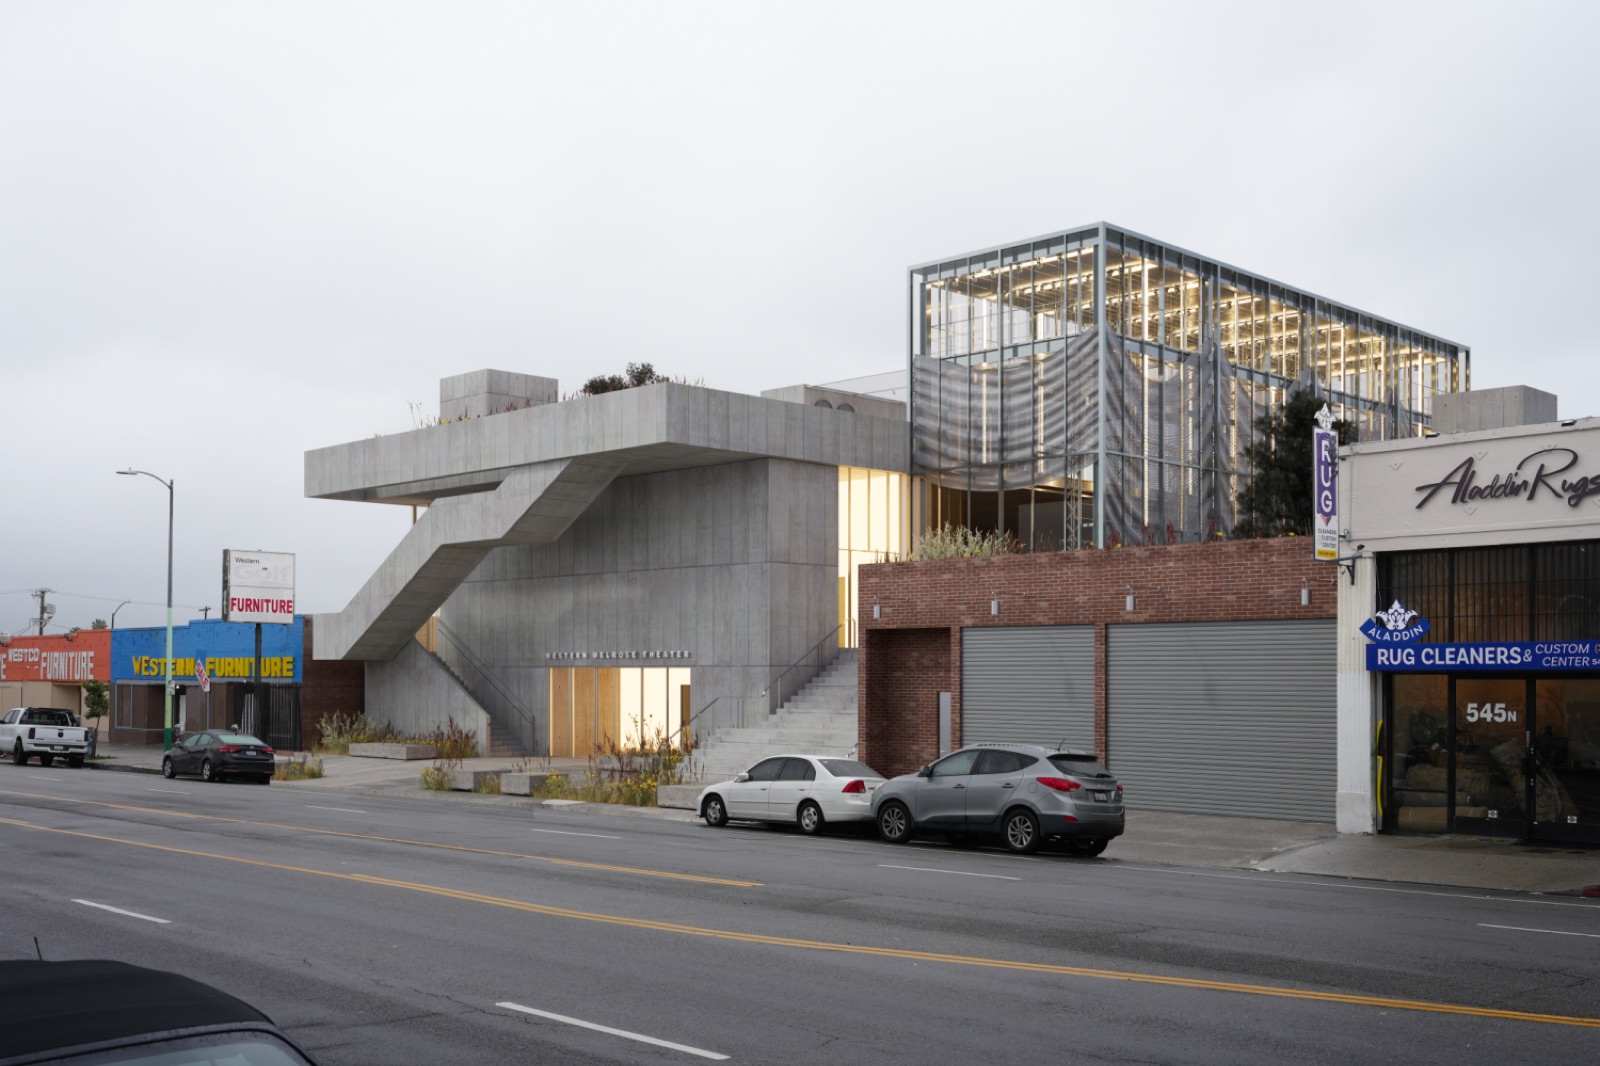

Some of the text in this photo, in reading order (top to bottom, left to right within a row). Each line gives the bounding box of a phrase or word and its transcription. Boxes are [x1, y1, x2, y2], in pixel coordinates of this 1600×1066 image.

[1320, 440, 1333, 513] RUG
[1415, 448, 1600, 509] Aladdin Rugs
[235, 556, 260, 565] Western
[230, 597, 293, 614] FURNITURE
[1367, 624, 1424, 642] ALADDIN
[8, 648, 40, 662] WESTCO
[545, 650, 690, 659] WESTERN MELROSE THEATER
[1377, 647, 1533, 665] RUG CLEANERS &
[1535, 643, 1590, 655] CUSTOM
[40, 650, 95, 680] FURNITURE
[205, 656, 294, 677] FURNITURE
[1542, 656, 1590, 667] CENTER
[195, 661, 209, 690] SALE
